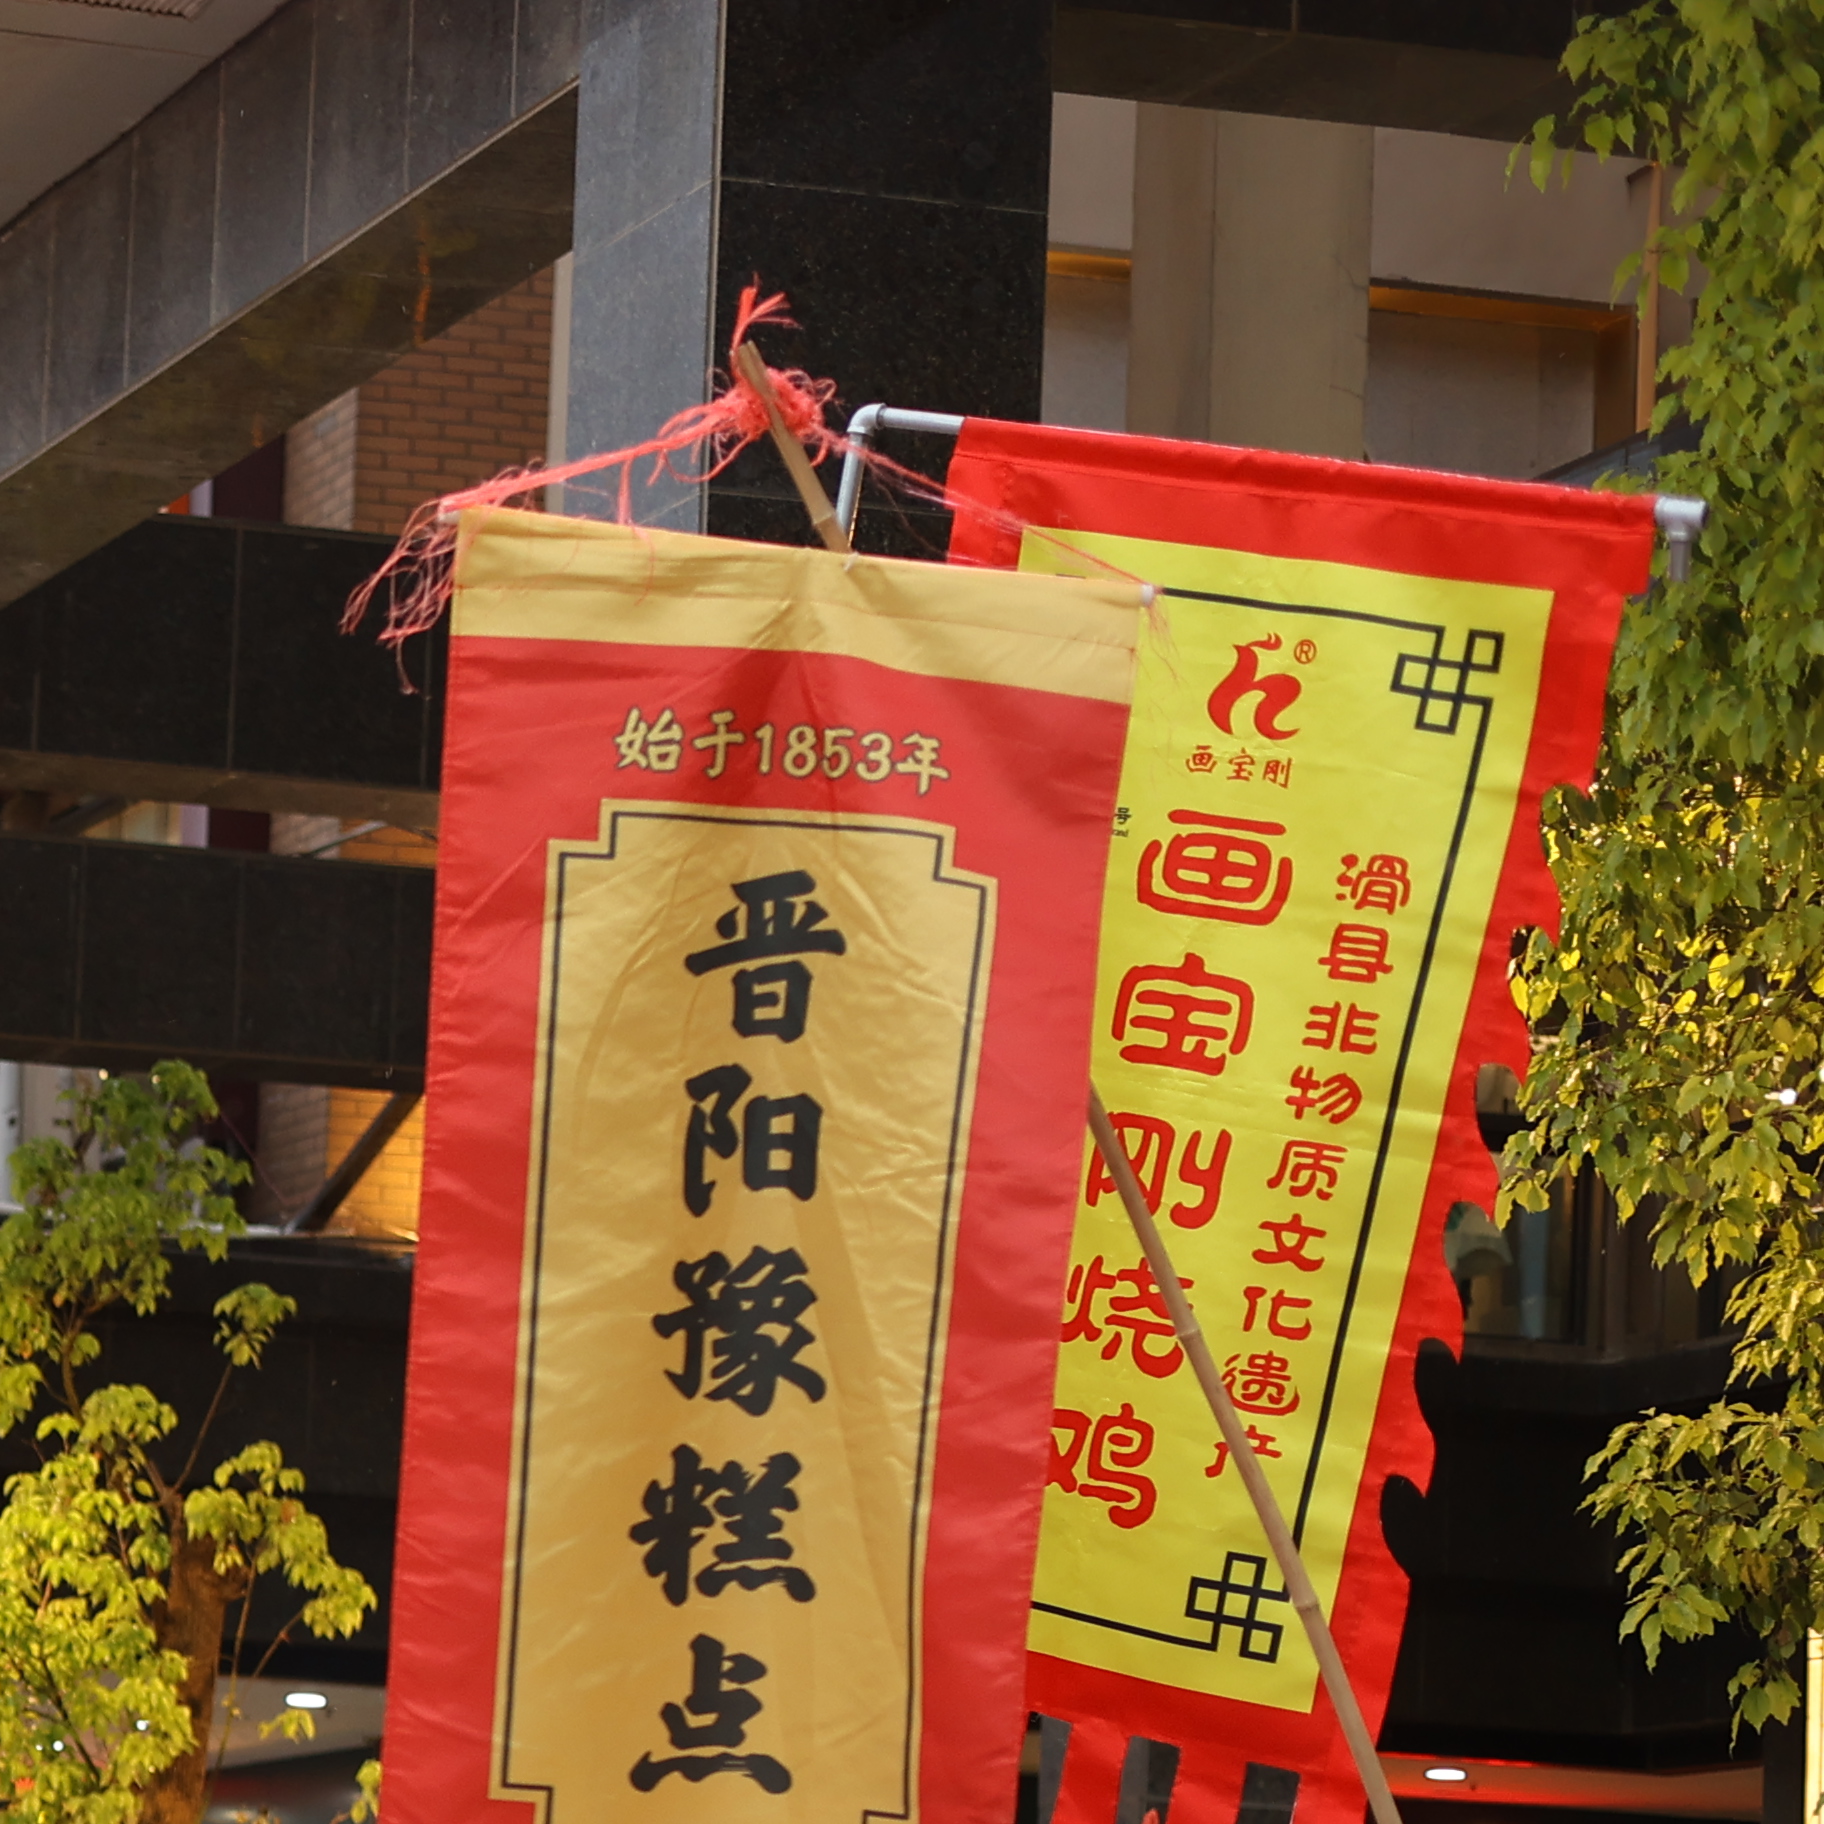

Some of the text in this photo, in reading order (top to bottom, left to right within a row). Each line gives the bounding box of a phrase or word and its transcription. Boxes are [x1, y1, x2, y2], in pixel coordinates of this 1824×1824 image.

[614, 707, 950, 796] 始于1853年
[1185, 745, 1294, 789] 画宝刚
[628, 871, 846, 1794] 晋阳豫糕点
[1042, 808, 1293, 1531] 画宝刚烧鸡
[1204, 852, 1411, 1480] 滑县非物质文化遗产
